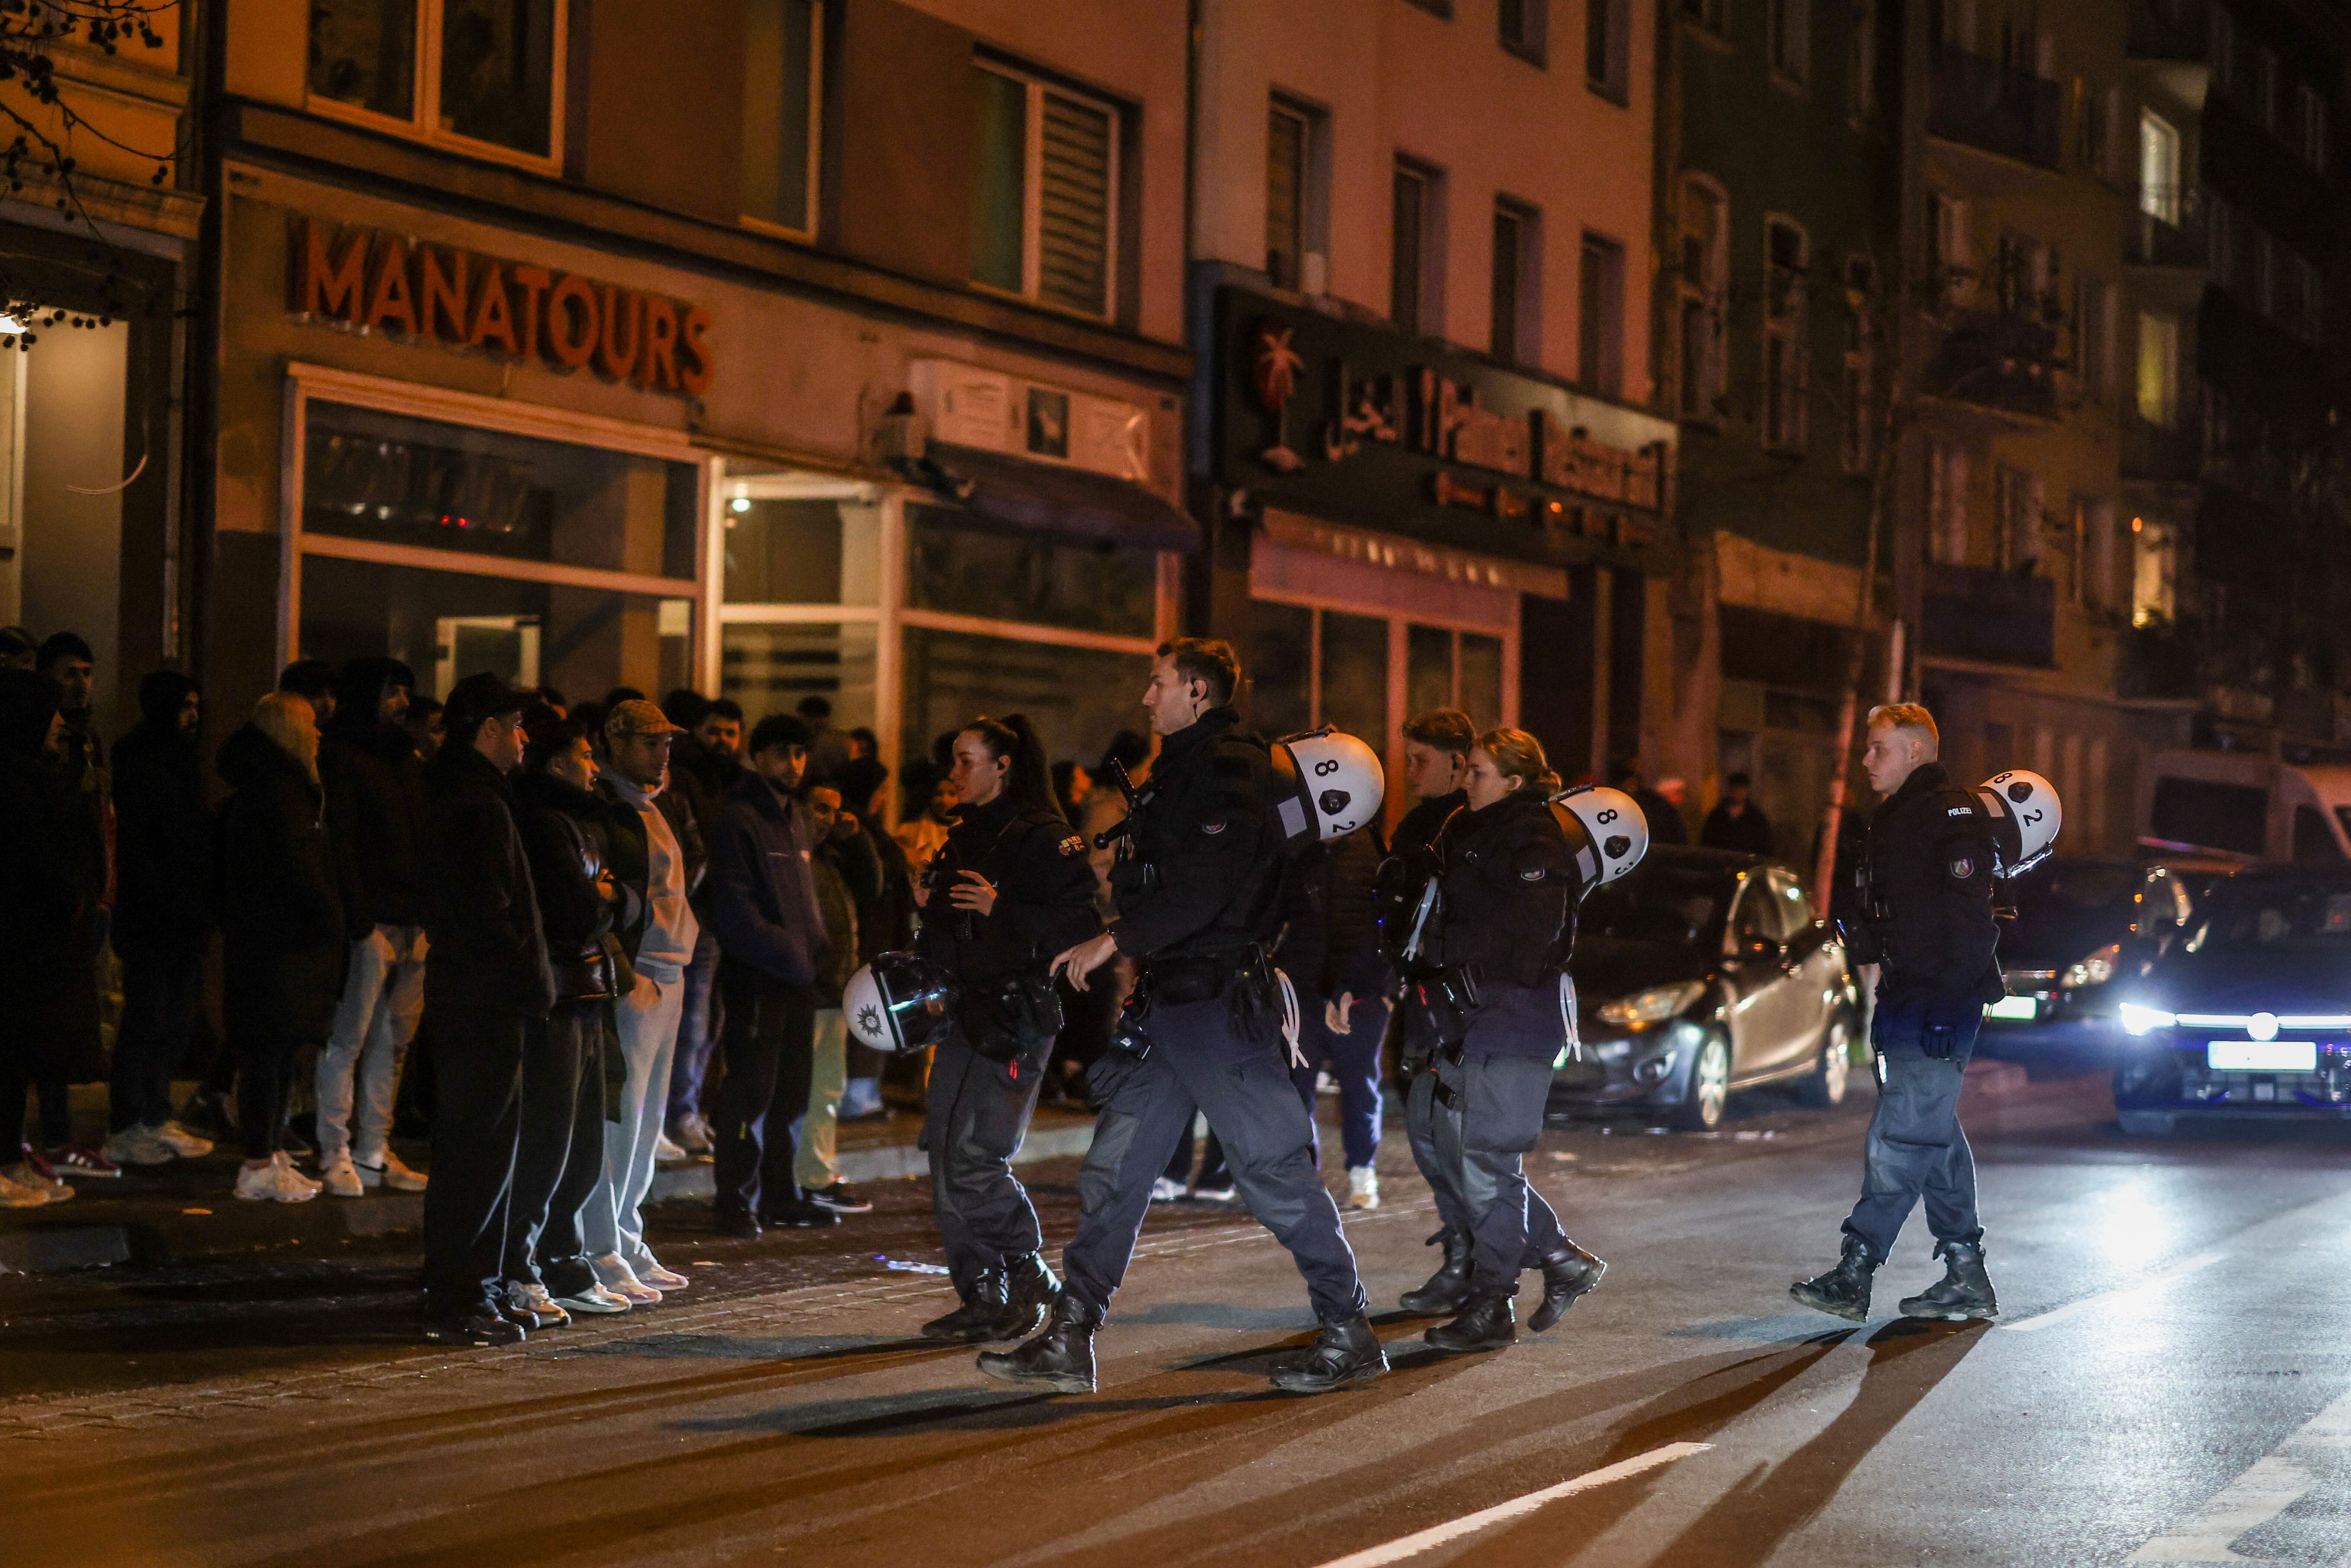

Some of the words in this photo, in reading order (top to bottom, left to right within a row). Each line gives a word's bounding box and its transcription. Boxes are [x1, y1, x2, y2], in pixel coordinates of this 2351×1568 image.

[303, 220, 714, 396] MANATOURS
[1315, 759, 1339, 776] 8
[1332, 821, 1356, 833] 2
[1596, 809, 1617, 825] 8
[1947, 807, 1972, 817] POLIZEI
[1994, 773, 2012, 783] 8
[2023, 809, 2042, 827] 2
